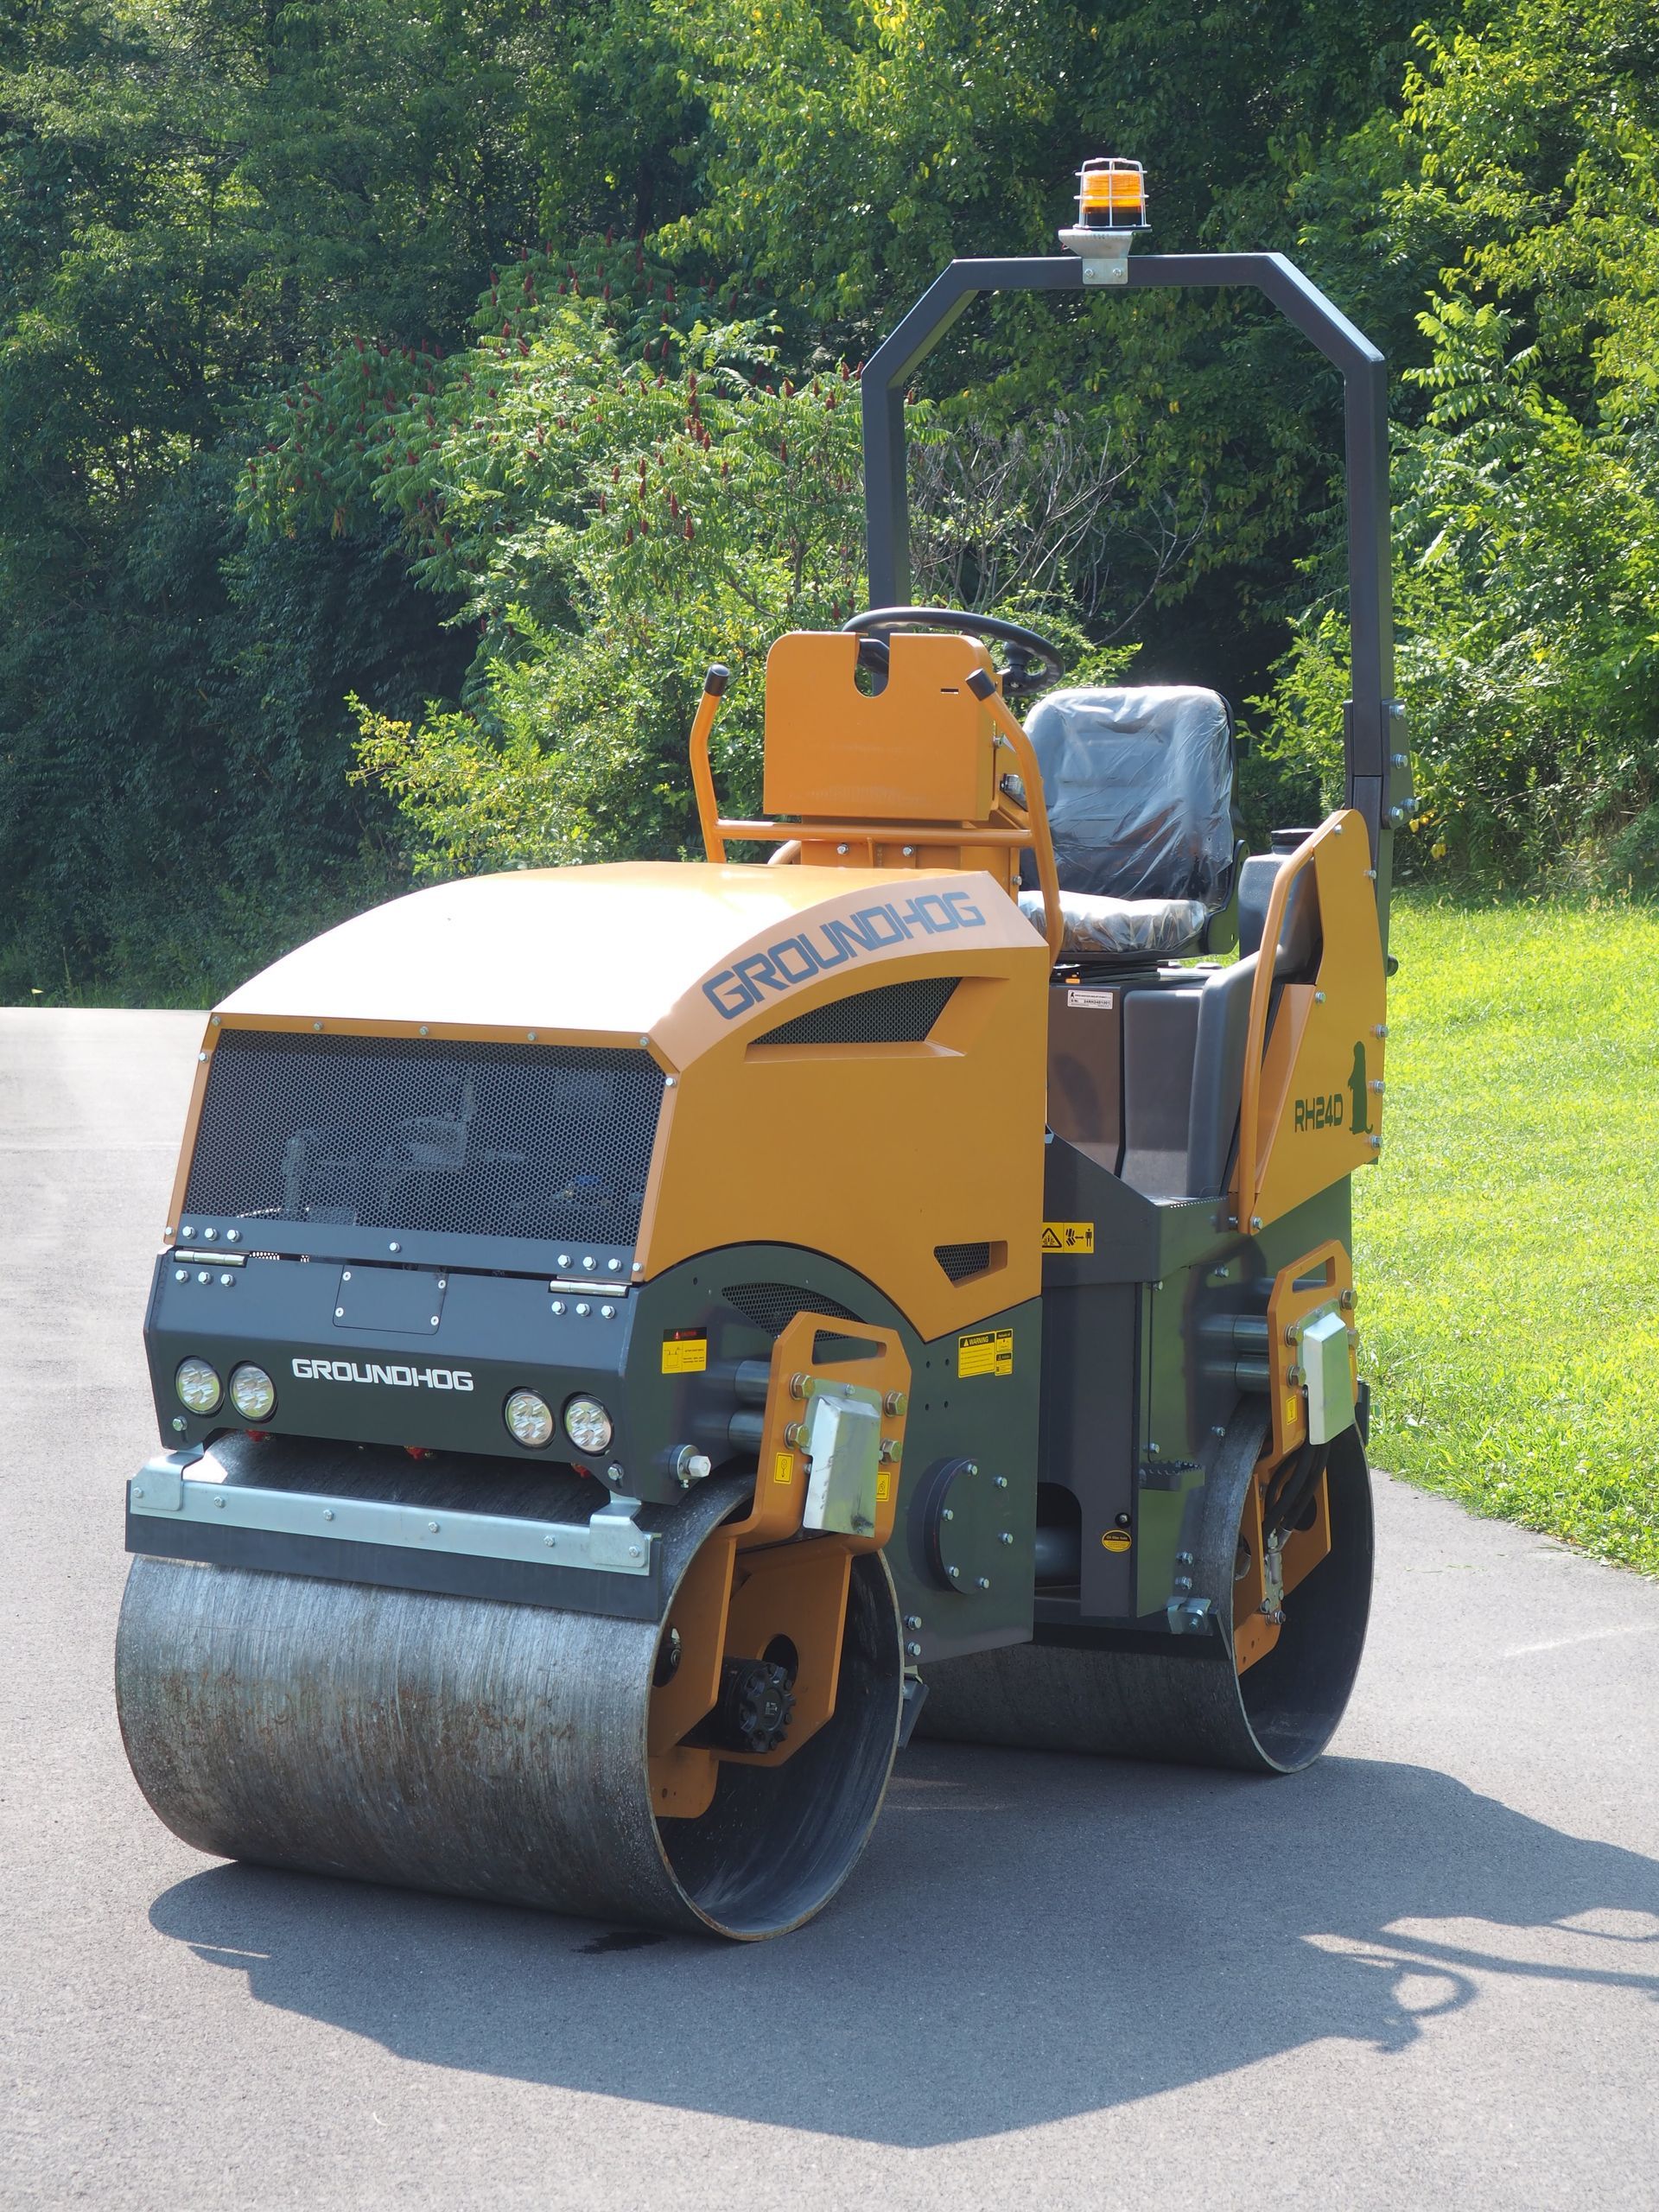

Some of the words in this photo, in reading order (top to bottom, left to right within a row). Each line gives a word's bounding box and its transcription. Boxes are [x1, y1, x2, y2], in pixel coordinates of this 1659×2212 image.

[702, 892, 986, 1020] GROUNDHOG
[969, 1336, 989, 1346] WARNING
[292, 1358, 474, 1391] GROUNDHOG
